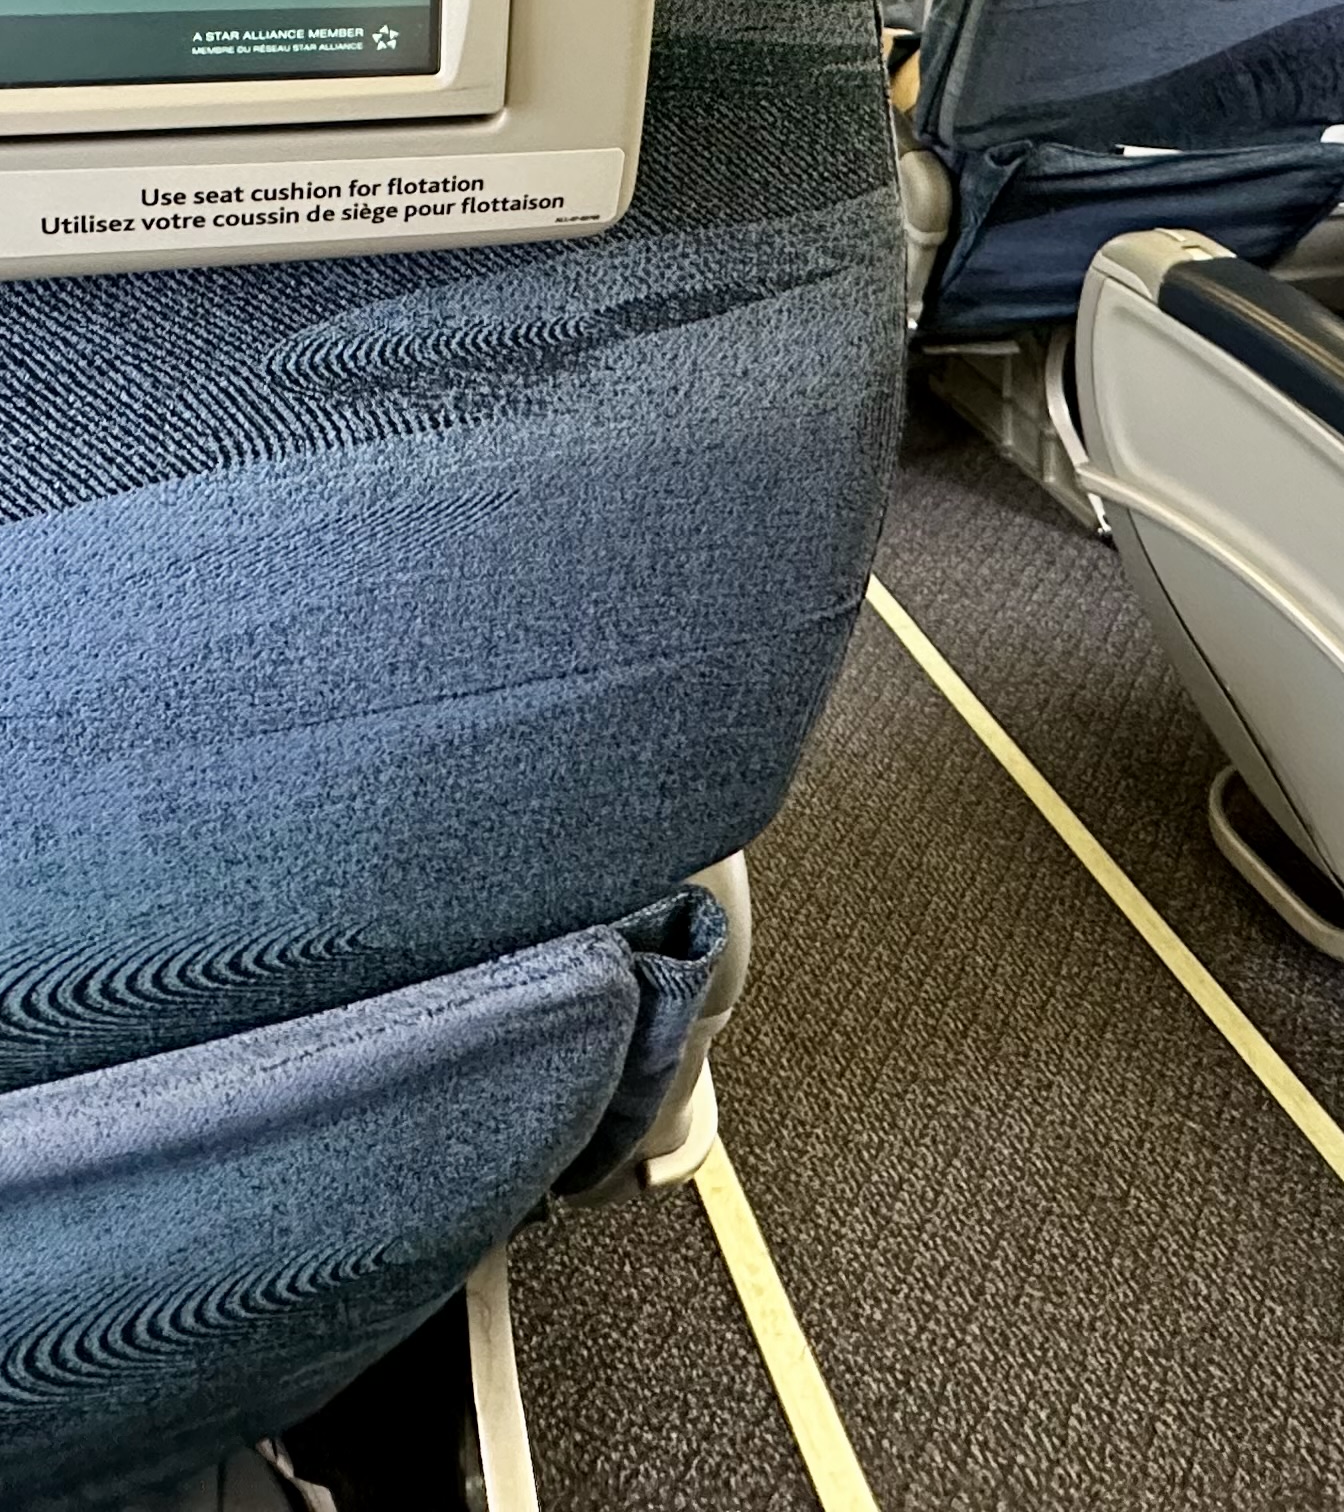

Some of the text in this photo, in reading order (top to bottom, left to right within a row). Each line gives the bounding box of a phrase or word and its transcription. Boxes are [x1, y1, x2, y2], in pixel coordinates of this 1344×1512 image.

[192, 28, 364, 42] A STAR ALLIANCE MEMBER
[293, 43, 316, 52] STAR
[318, 41, 364, 51] ALLIANCE
[140, 175, 485, 207] Use seat cushion for flotation
[41, 193, 565, 236] Utilisez votre coussin de siège pour flottaison
